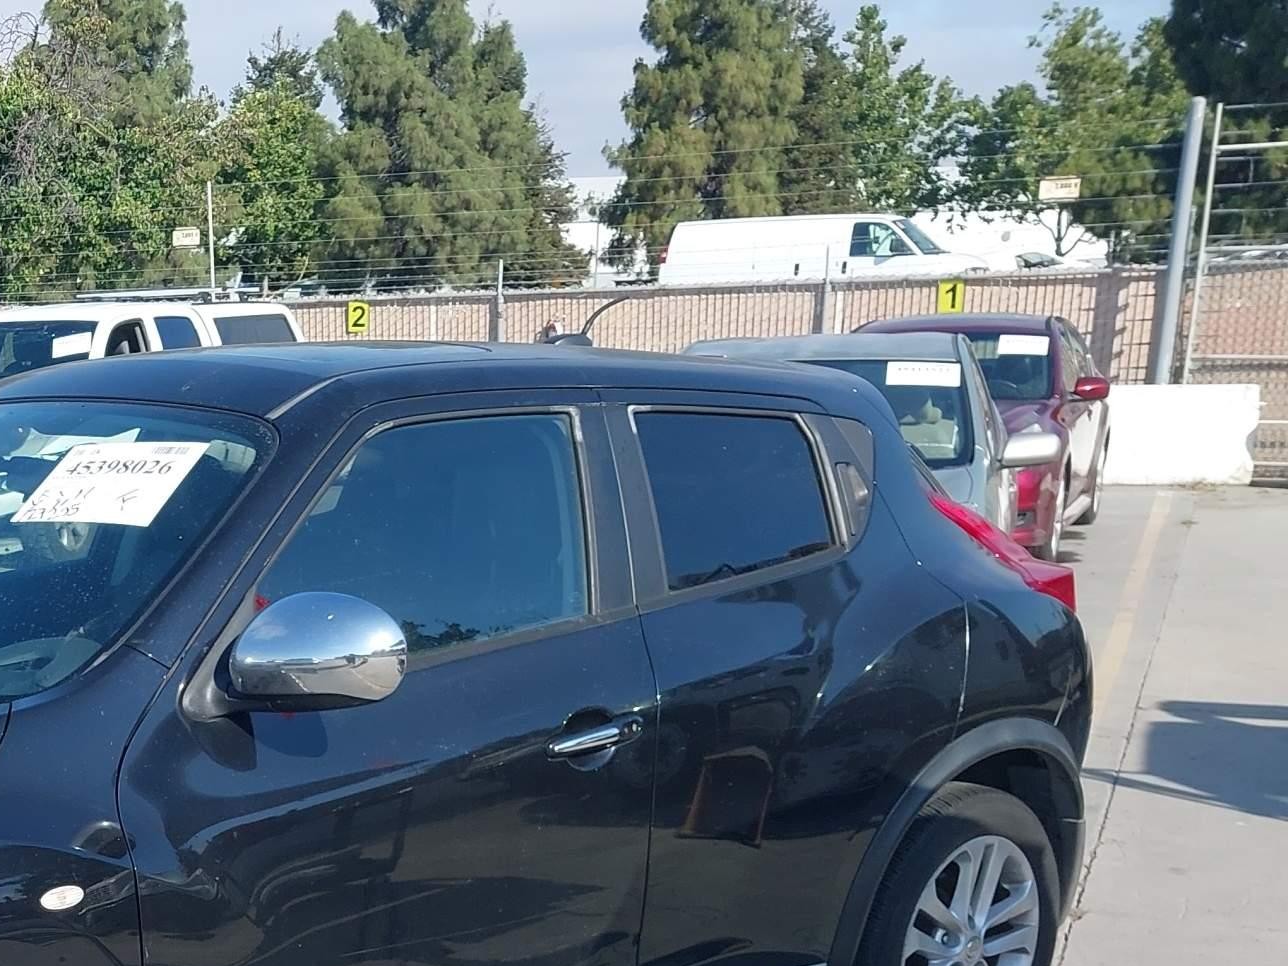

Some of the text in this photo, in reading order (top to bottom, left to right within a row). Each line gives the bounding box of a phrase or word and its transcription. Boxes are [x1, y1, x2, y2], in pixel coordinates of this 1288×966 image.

[945, 283, 957, 309] 1
[351, 305, 366, 328] 2
[66, 459, 176, 476] 45398026
